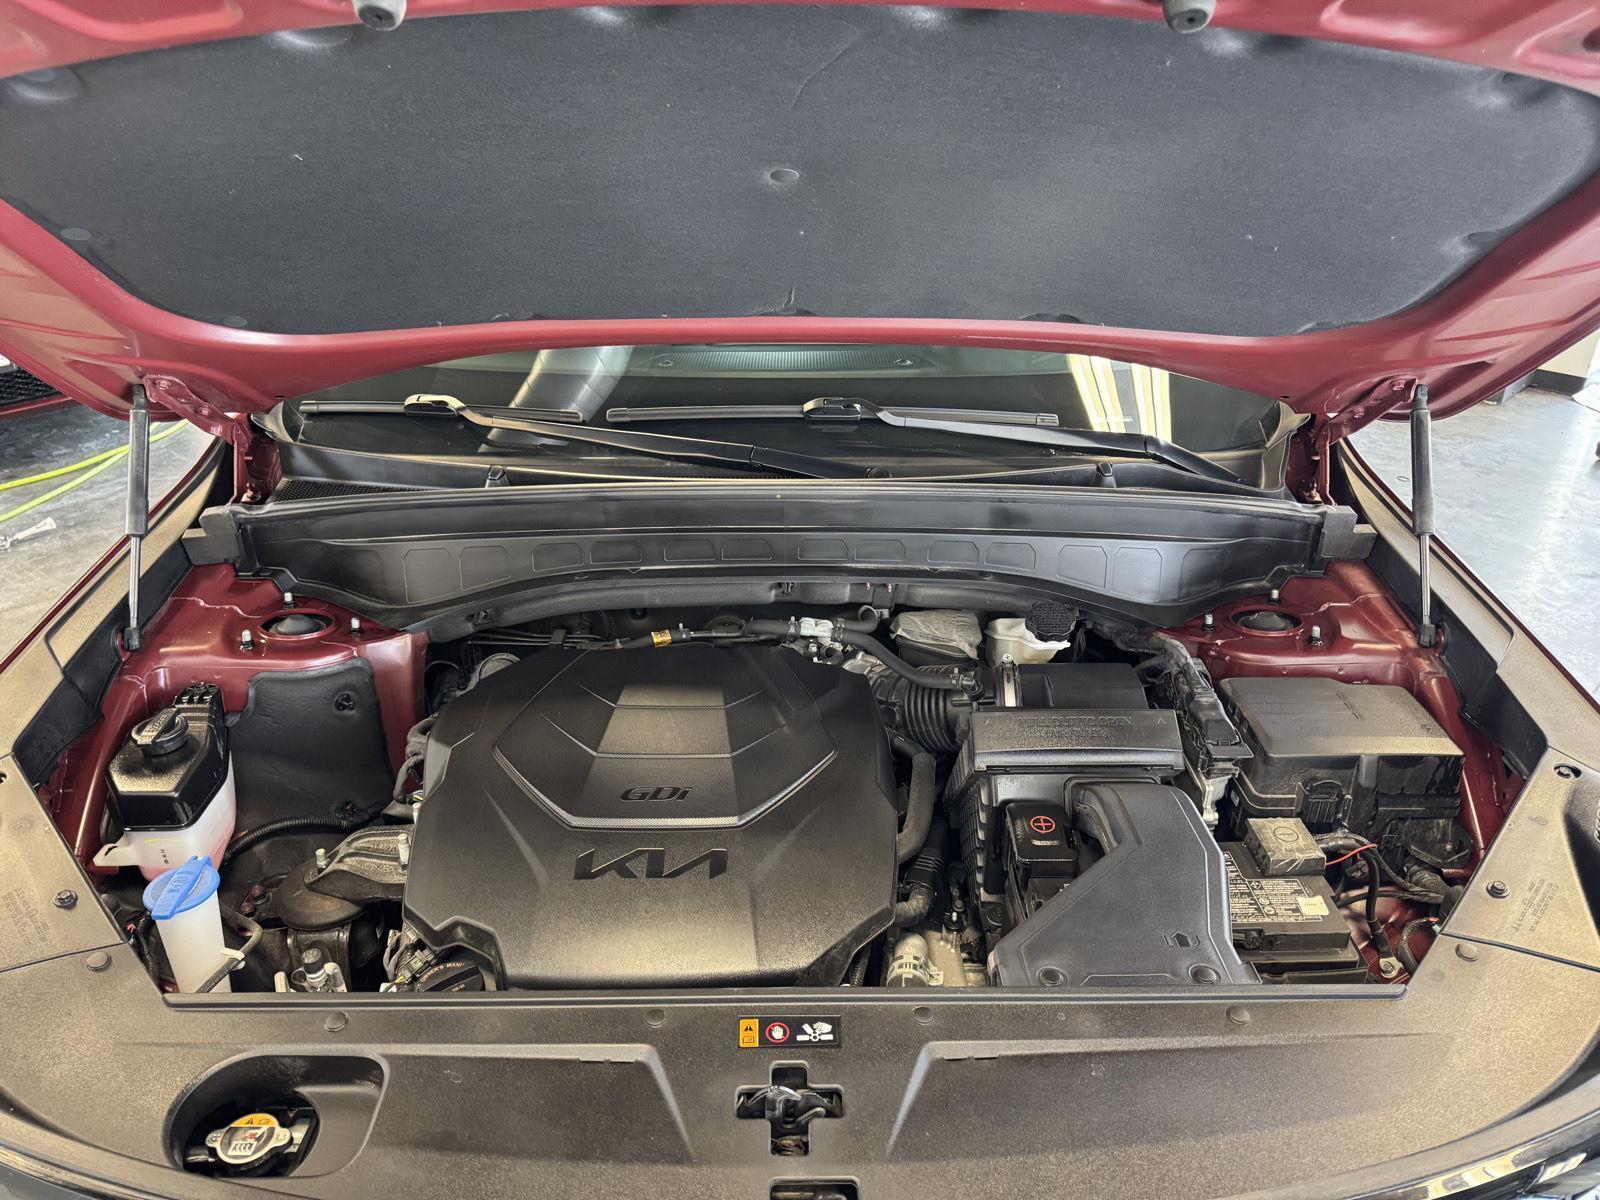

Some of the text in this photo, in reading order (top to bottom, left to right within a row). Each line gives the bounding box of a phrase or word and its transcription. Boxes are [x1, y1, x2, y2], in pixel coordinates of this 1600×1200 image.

[1099, 716, 1133, 727] OPEN
[619, 786, 694, 802] GDi
[573, 847, 729, 880] KIA
